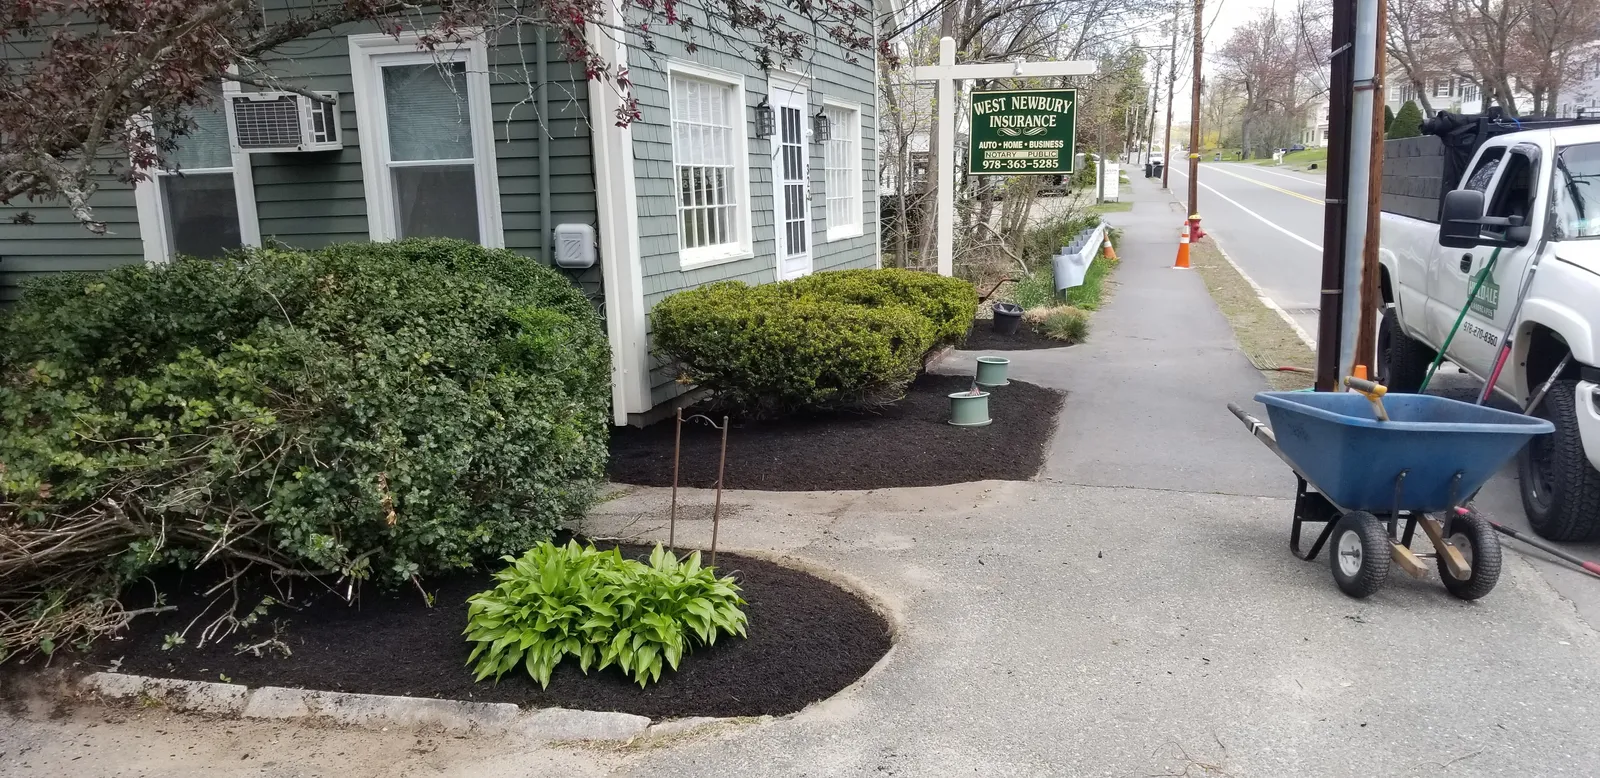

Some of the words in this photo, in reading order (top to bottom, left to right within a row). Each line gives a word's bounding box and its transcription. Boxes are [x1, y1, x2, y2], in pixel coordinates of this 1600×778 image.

[973, 97, 1006, 116] WEST
[1011, 96, 1073, 114] NEWBURY
[989, 114, 1057, 128] INSURANCE
[978, 141, 997, 149] AUTO
[1003, 141, 1023, 149] HOME
[1029, 140, 1064, 148] BUSINESS
[982, 159, 1059, 169] 978-363-5285
[1468, 280, 1498, 305] HILDALE
[1463, 321, 1498, 346] 978-270-8360
